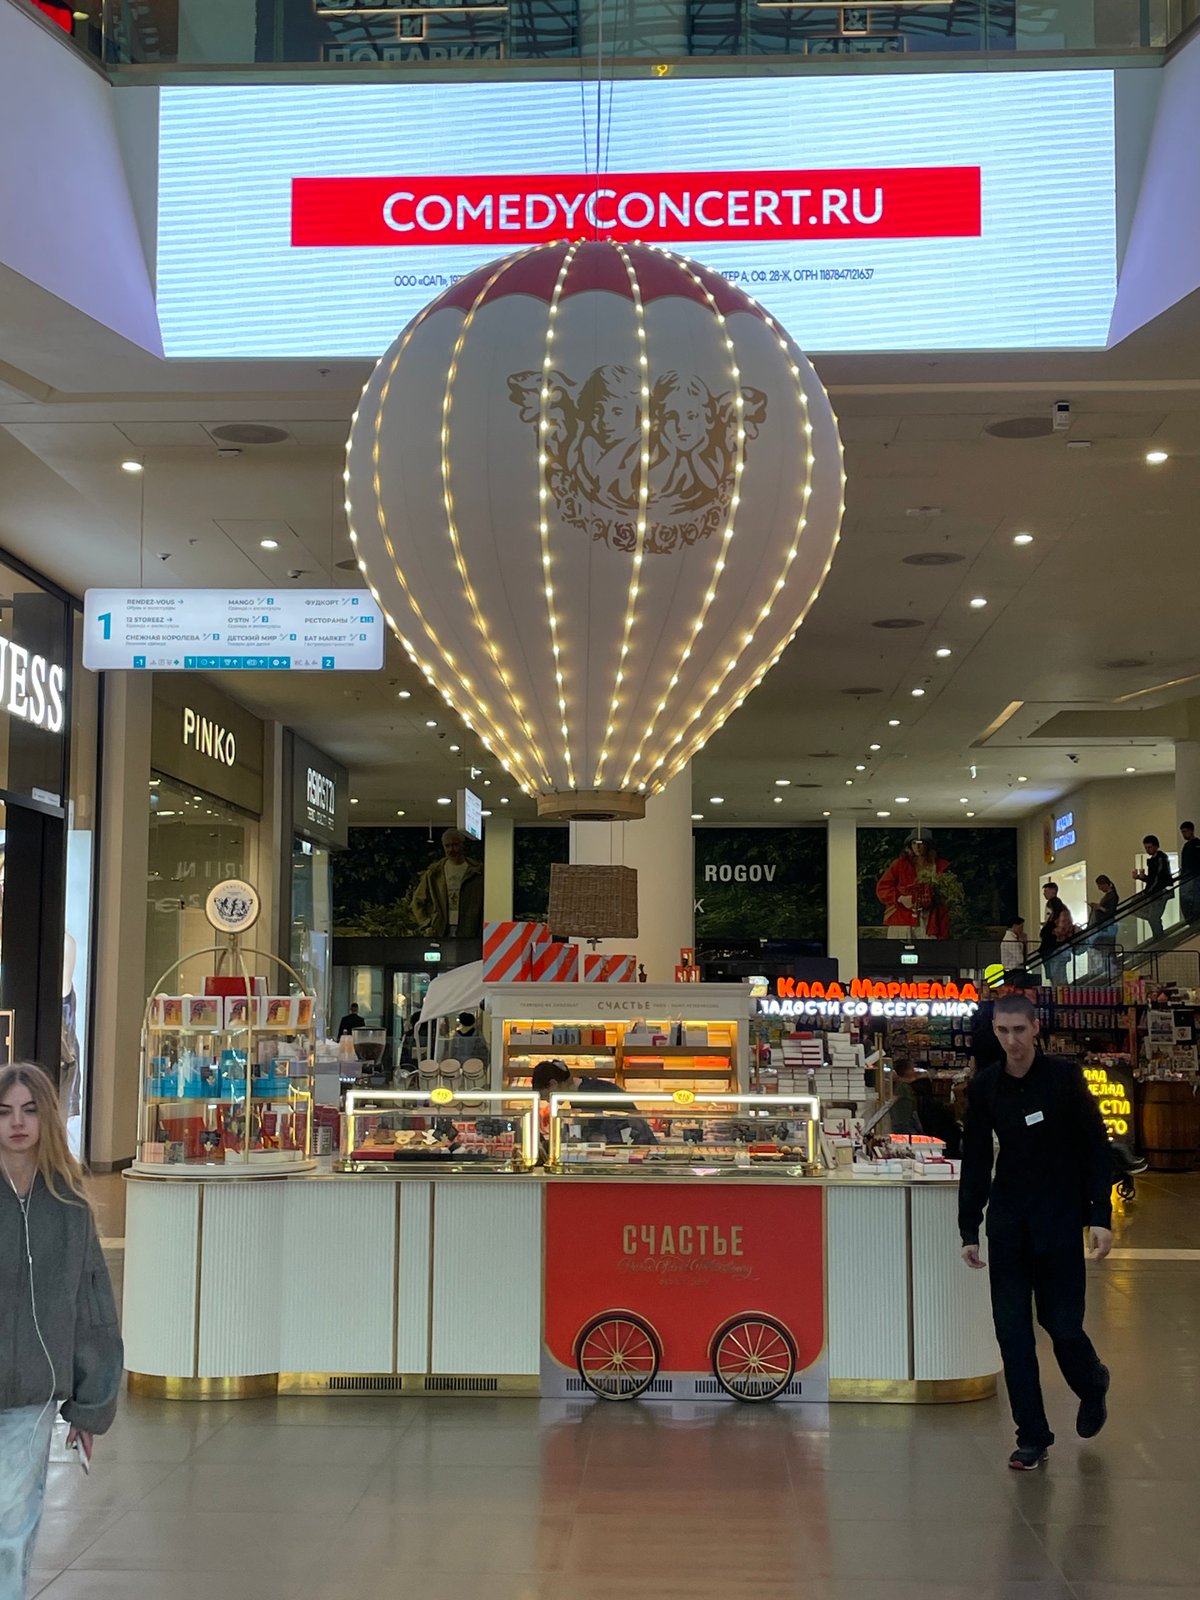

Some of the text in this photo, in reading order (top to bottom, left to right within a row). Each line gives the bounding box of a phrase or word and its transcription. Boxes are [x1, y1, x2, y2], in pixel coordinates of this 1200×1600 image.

[382, 187, 884, 233] COMEDYCONCERT.RU
[394, 275, 417, 287] ООО
[793, 269, 818, 281] ОГРН
[97, 612, 112, 640] 1
[227, 634, 260, 642] ДЕТСКИЙ
[325, 659, 331, 667] 2
[183, 707, 236, 767] PINKO
[704, 864, 777, 882] ROGOV
[597, 1001, 651, 1010] СЧАСТЬЕ
[842, 1001, 868, 1016] СО
[869, 1001, 929, 1016] ВСЕГО
[622, 1224, 744, 1256] СЧАСТЬЕ
